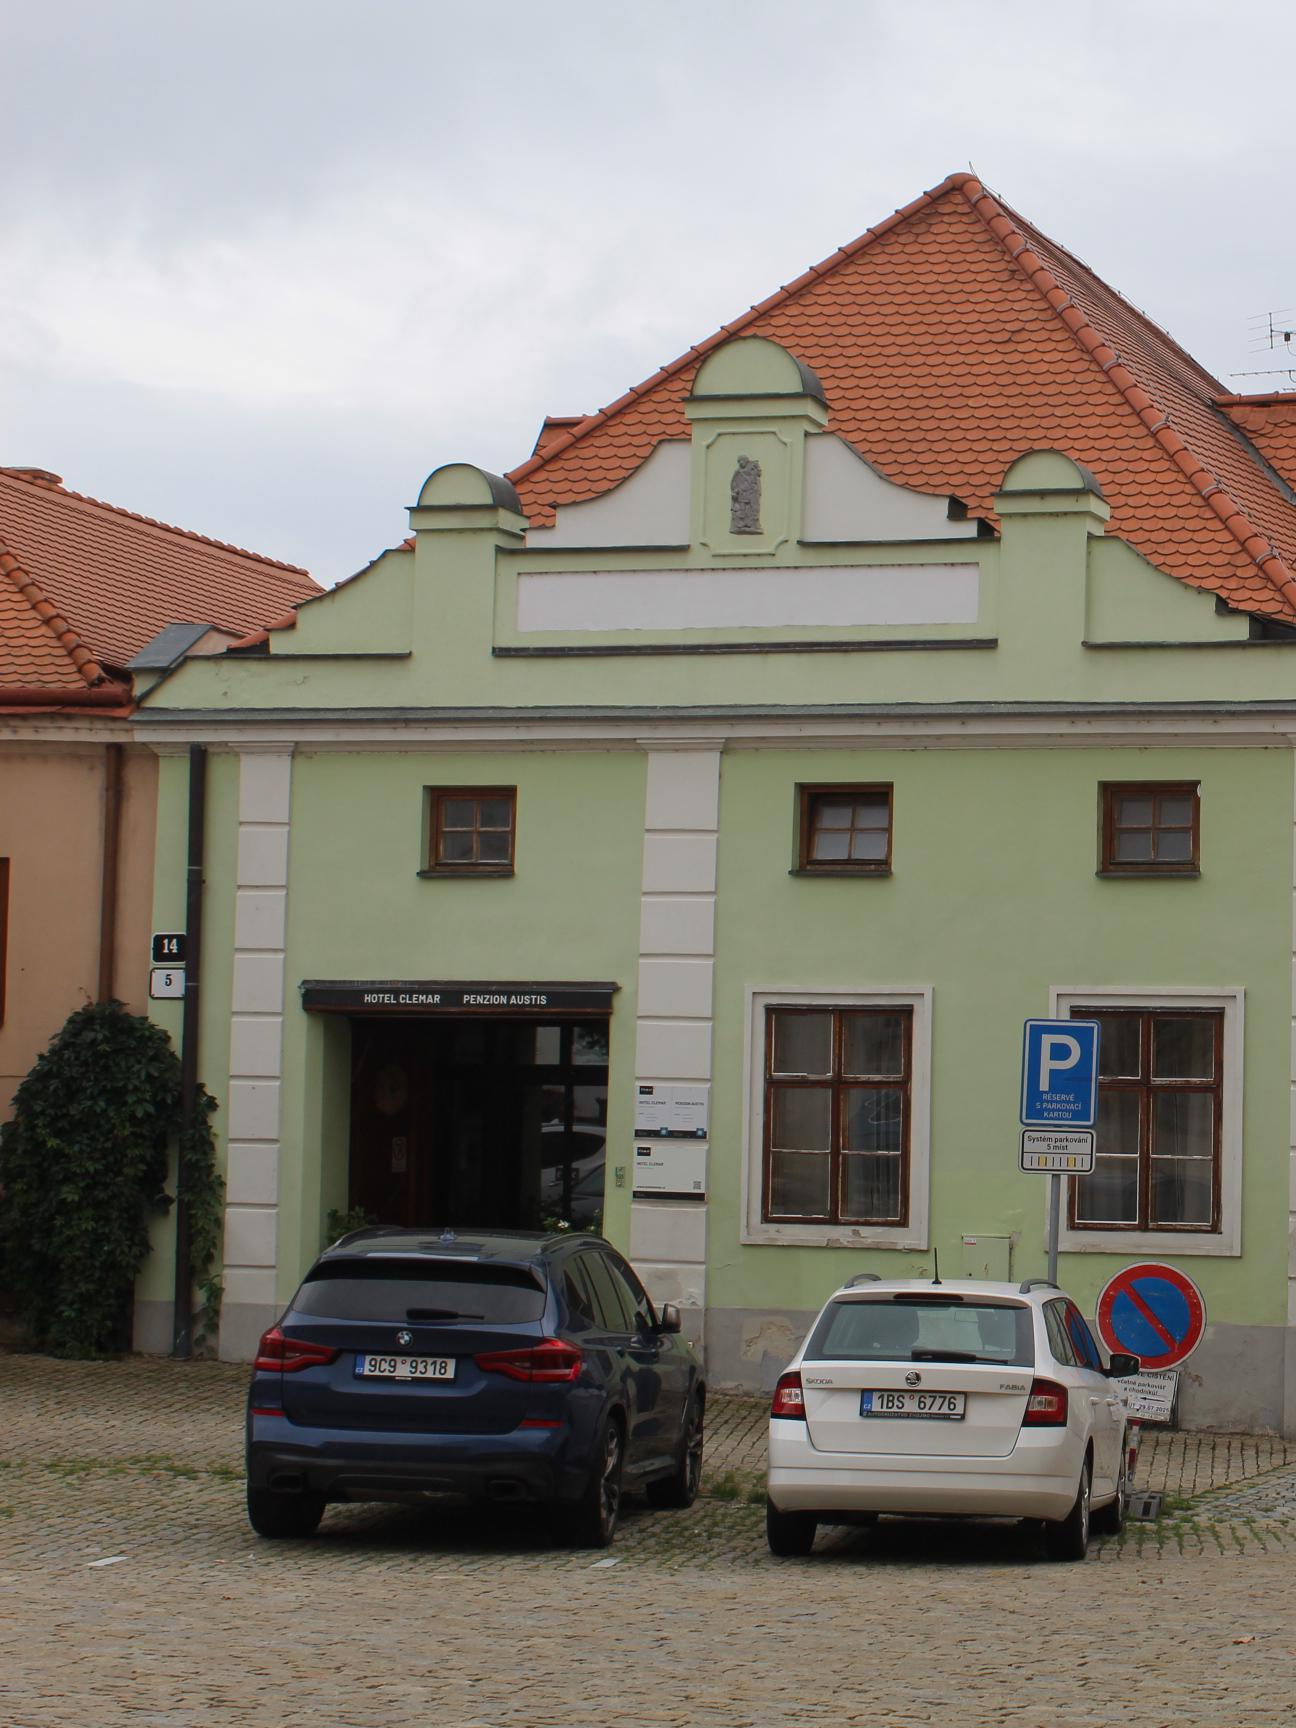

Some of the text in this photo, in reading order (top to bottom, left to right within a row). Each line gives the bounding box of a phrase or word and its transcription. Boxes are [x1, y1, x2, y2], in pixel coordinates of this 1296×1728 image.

[162, 938, 178, 953] 14
[164, 973, 172, 987] 5
[364, 993, 441, 1004] HOTEL CLEMAR
[463, 994, 547, 1005] PENZION AUSTIS
[1039, 1033, 1081, 1091] P
[1042, 1102, 1082, 1111] PARKOVACÍ
[1043, 1111, 1073, 1119] KARTOU
[1027, 1135, 1089, 1144] Systém parkování
[368, 1358, 397, 1374] 9C9
[409, 1360, 448, 1375] 9318
[999, 1383, 1026, 1391] FABIA
[878, 1393, 905, 1409] 1BS
[917, 1395, 957, 1411] 6776
